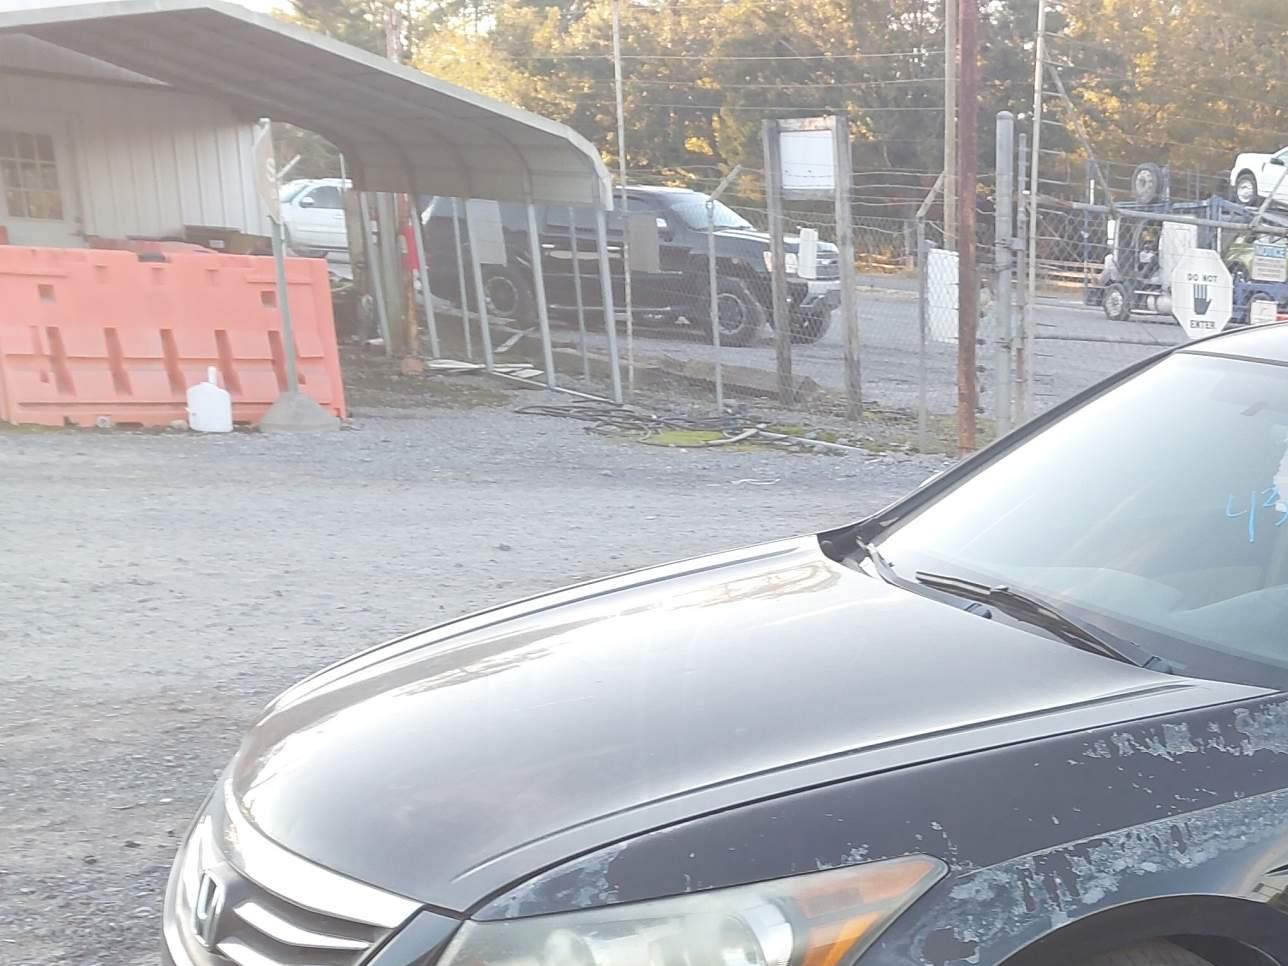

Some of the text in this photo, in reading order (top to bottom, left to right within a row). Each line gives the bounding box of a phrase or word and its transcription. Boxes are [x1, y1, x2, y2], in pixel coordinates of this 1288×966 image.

[1187, 273, 1218, 282] DO NOT
[1190, 320, 1216, 329] ENTER
